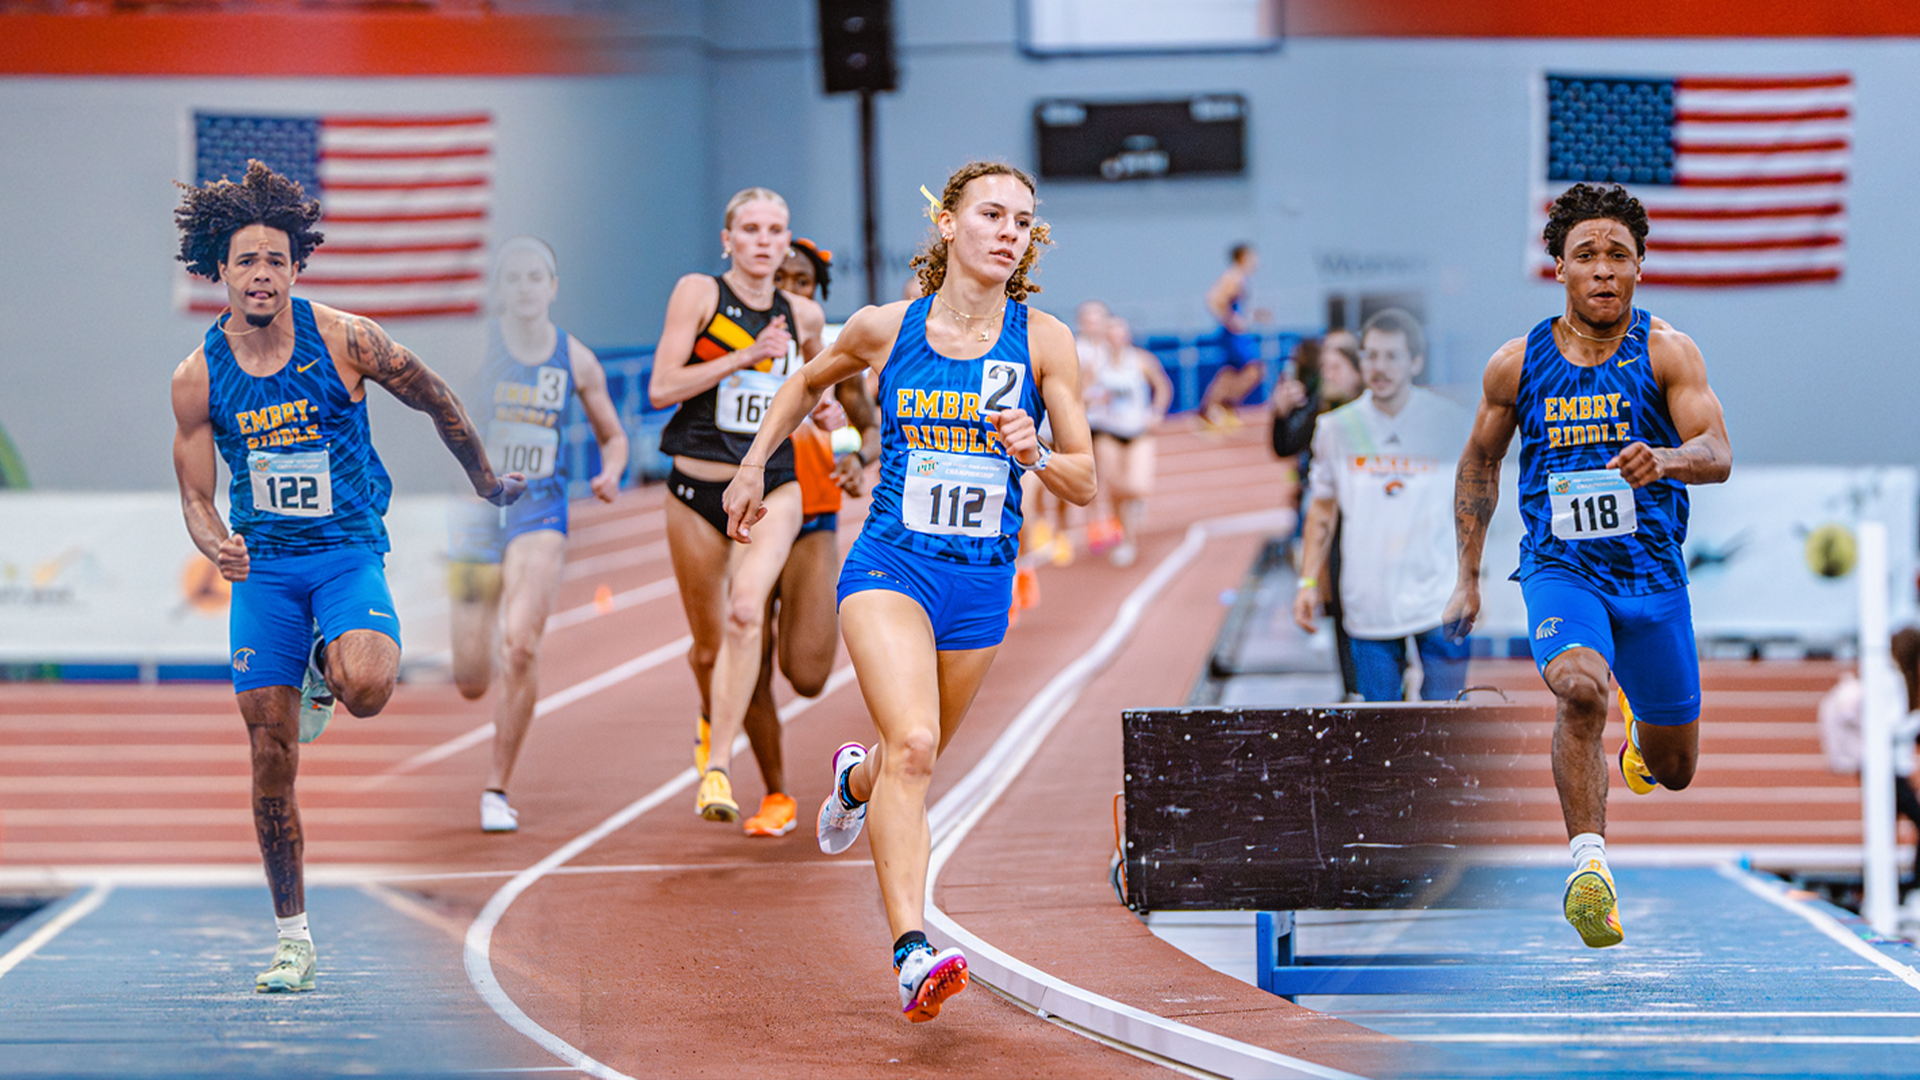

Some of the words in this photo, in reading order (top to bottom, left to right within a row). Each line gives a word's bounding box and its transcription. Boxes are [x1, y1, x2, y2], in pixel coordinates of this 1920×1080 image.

[543, 372, 559, 403] 3
[984, 365, 1017, 413] 2
[235, 399, 319, 434] EMBRY-
[897, 389, 992, 423] EMBR
[1544, 392, 1631, 422] EMBRY-
[1548, 422, 1631, 449] RIDDLE
[503, 445, 542, 473] 100
[266, 475, 319, 509] 122
[929, 483, 987, 528] 112
[1570, 493, 1620, 532] 118
